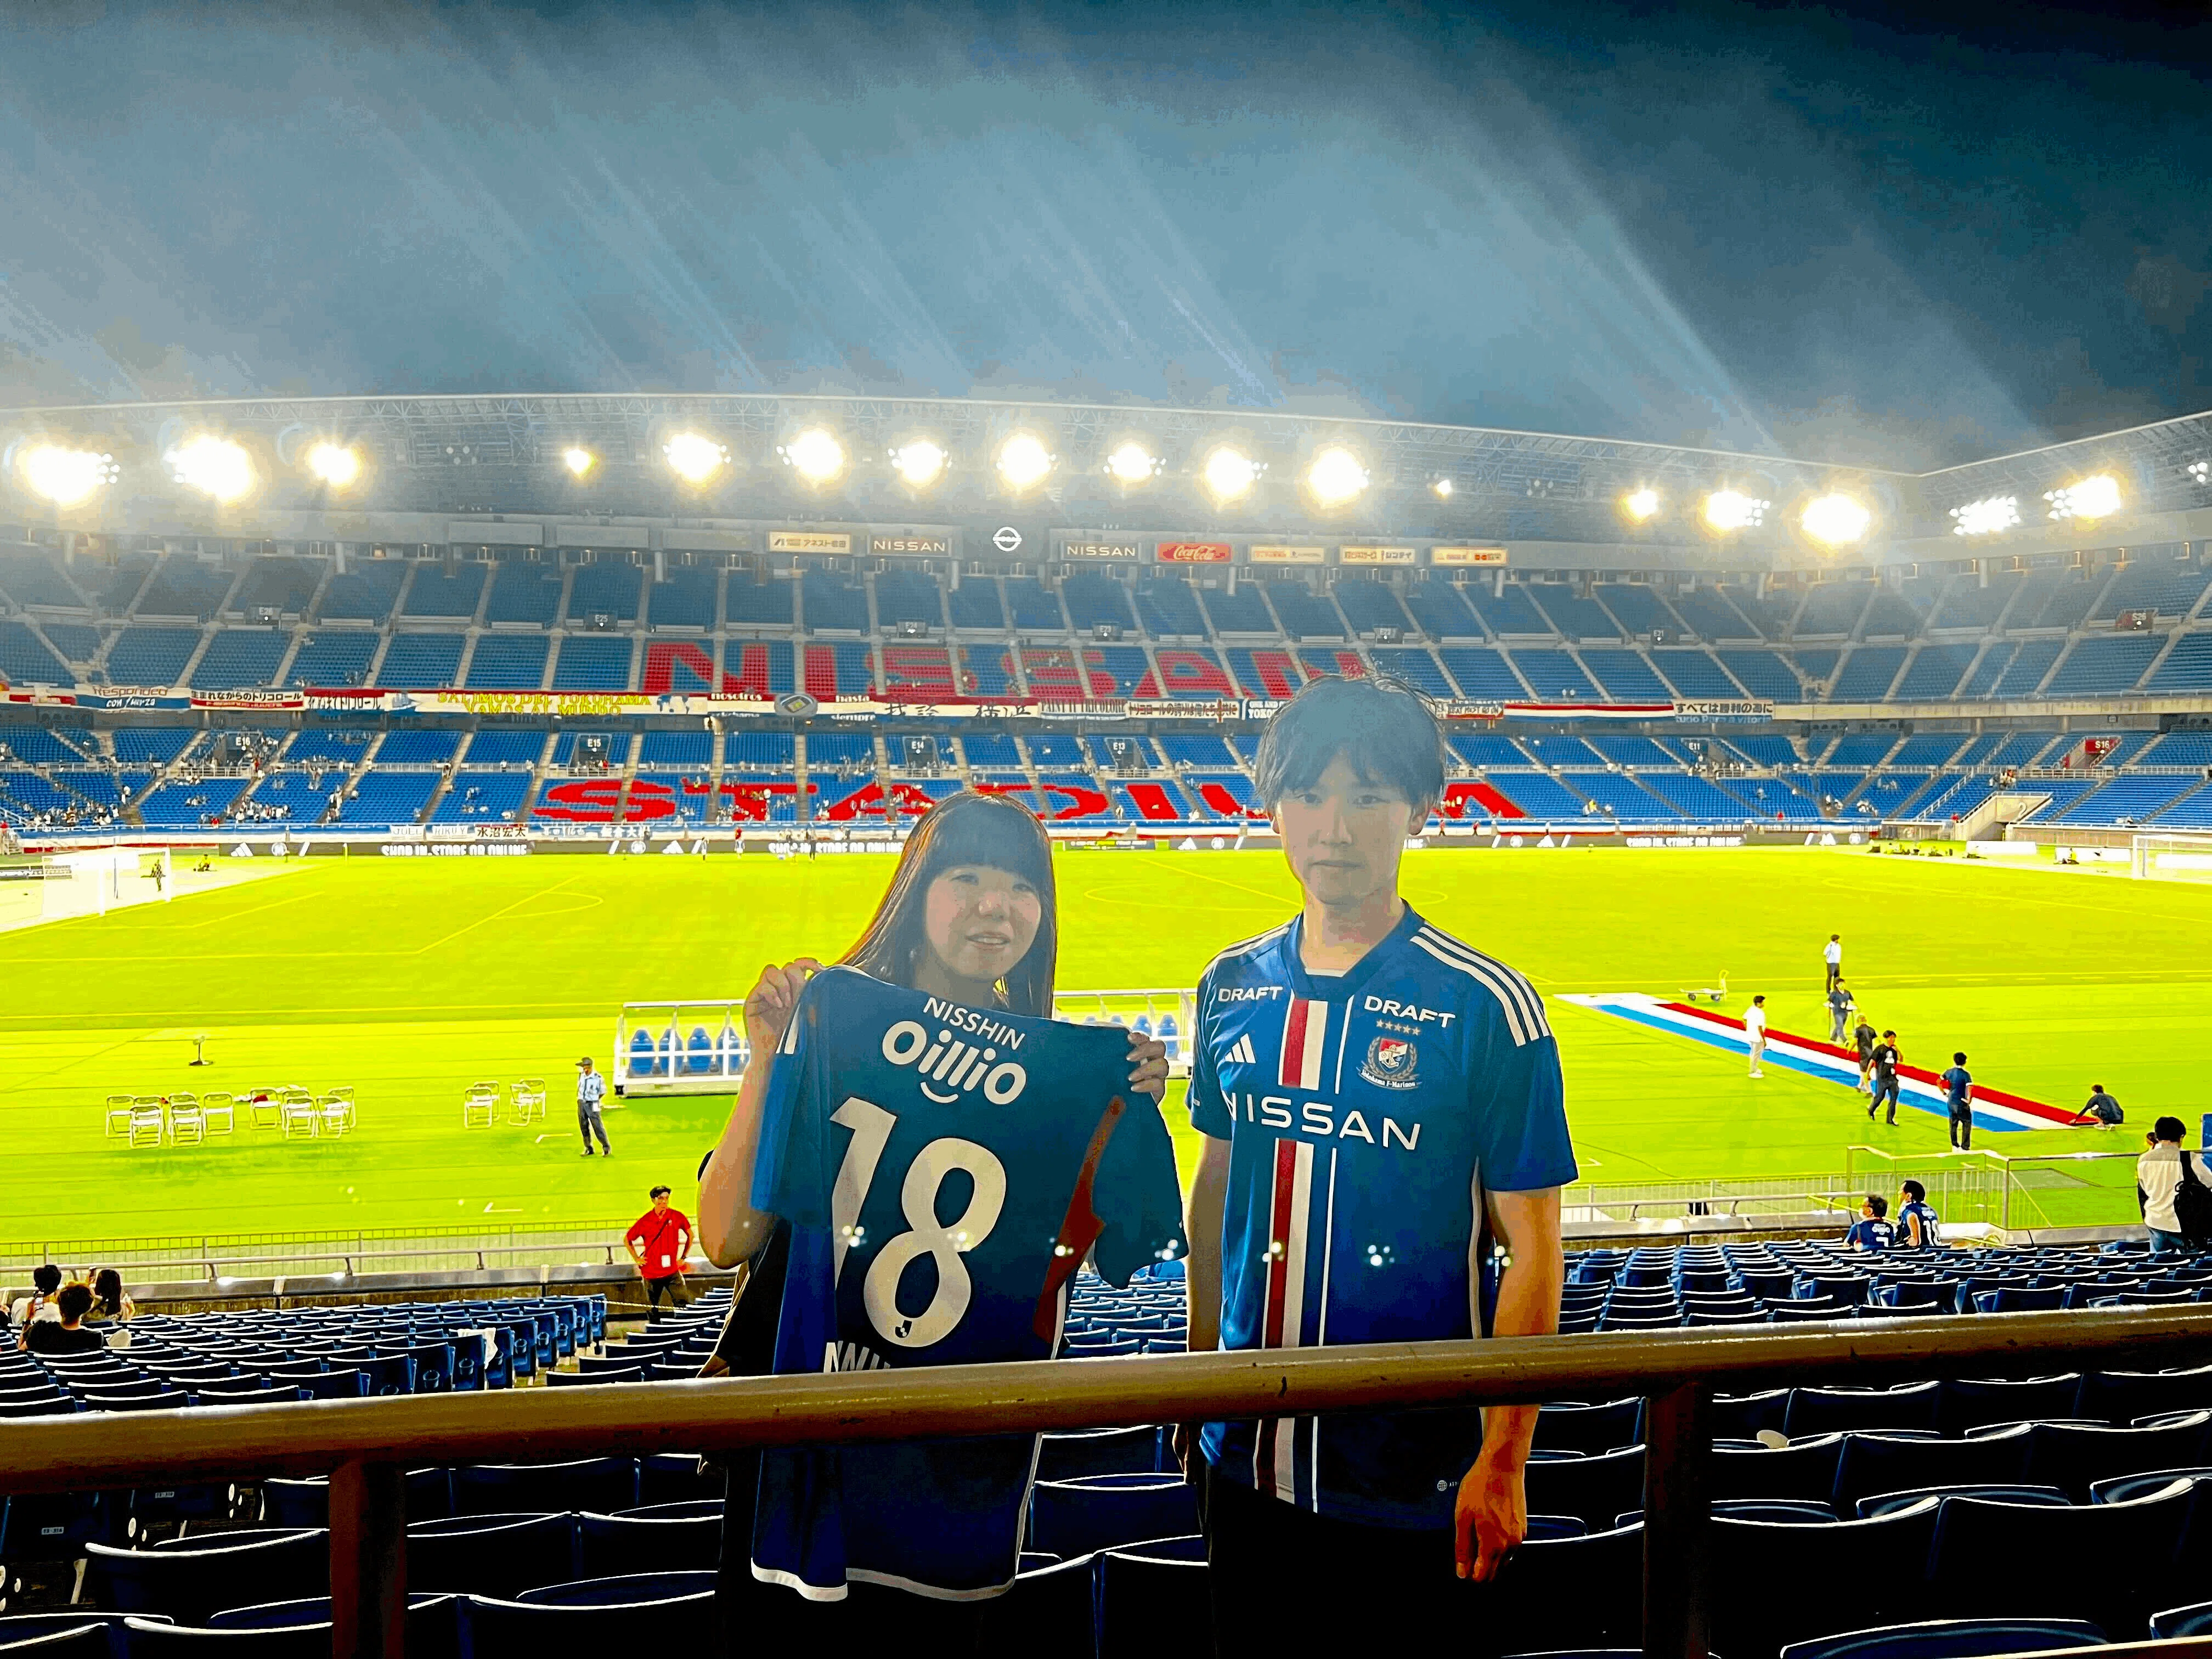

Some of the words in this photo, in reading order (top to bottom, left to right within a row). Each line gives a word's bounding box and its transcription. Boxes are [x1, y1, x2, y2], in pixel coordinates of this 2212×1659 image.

[873, 540, 946, 552] NISSAN
[1067, 546, 1136, 556] NISSAN
[595, 614, 608, 623] E25
[558, 694, 652, 706] YOKOHAMA
[235, 736, 251, 747] E16
[588, 739, 601, 748] E15
[911, 741, 924, 750] E14
[1113, 742, 1126, 751] E13
[1689, 742, 1701, 751] E11
[2094, 741, 2110, 749] S16
[2017, 802, 2028, 817] 2
[1218, 986, 1283, 1002] DRAFT
[1364, 996, 1456, 1028] DRAFT
[923, 997, 1025, 1050] NISSHIN
[830, 1097, 1007, 1347] 18
